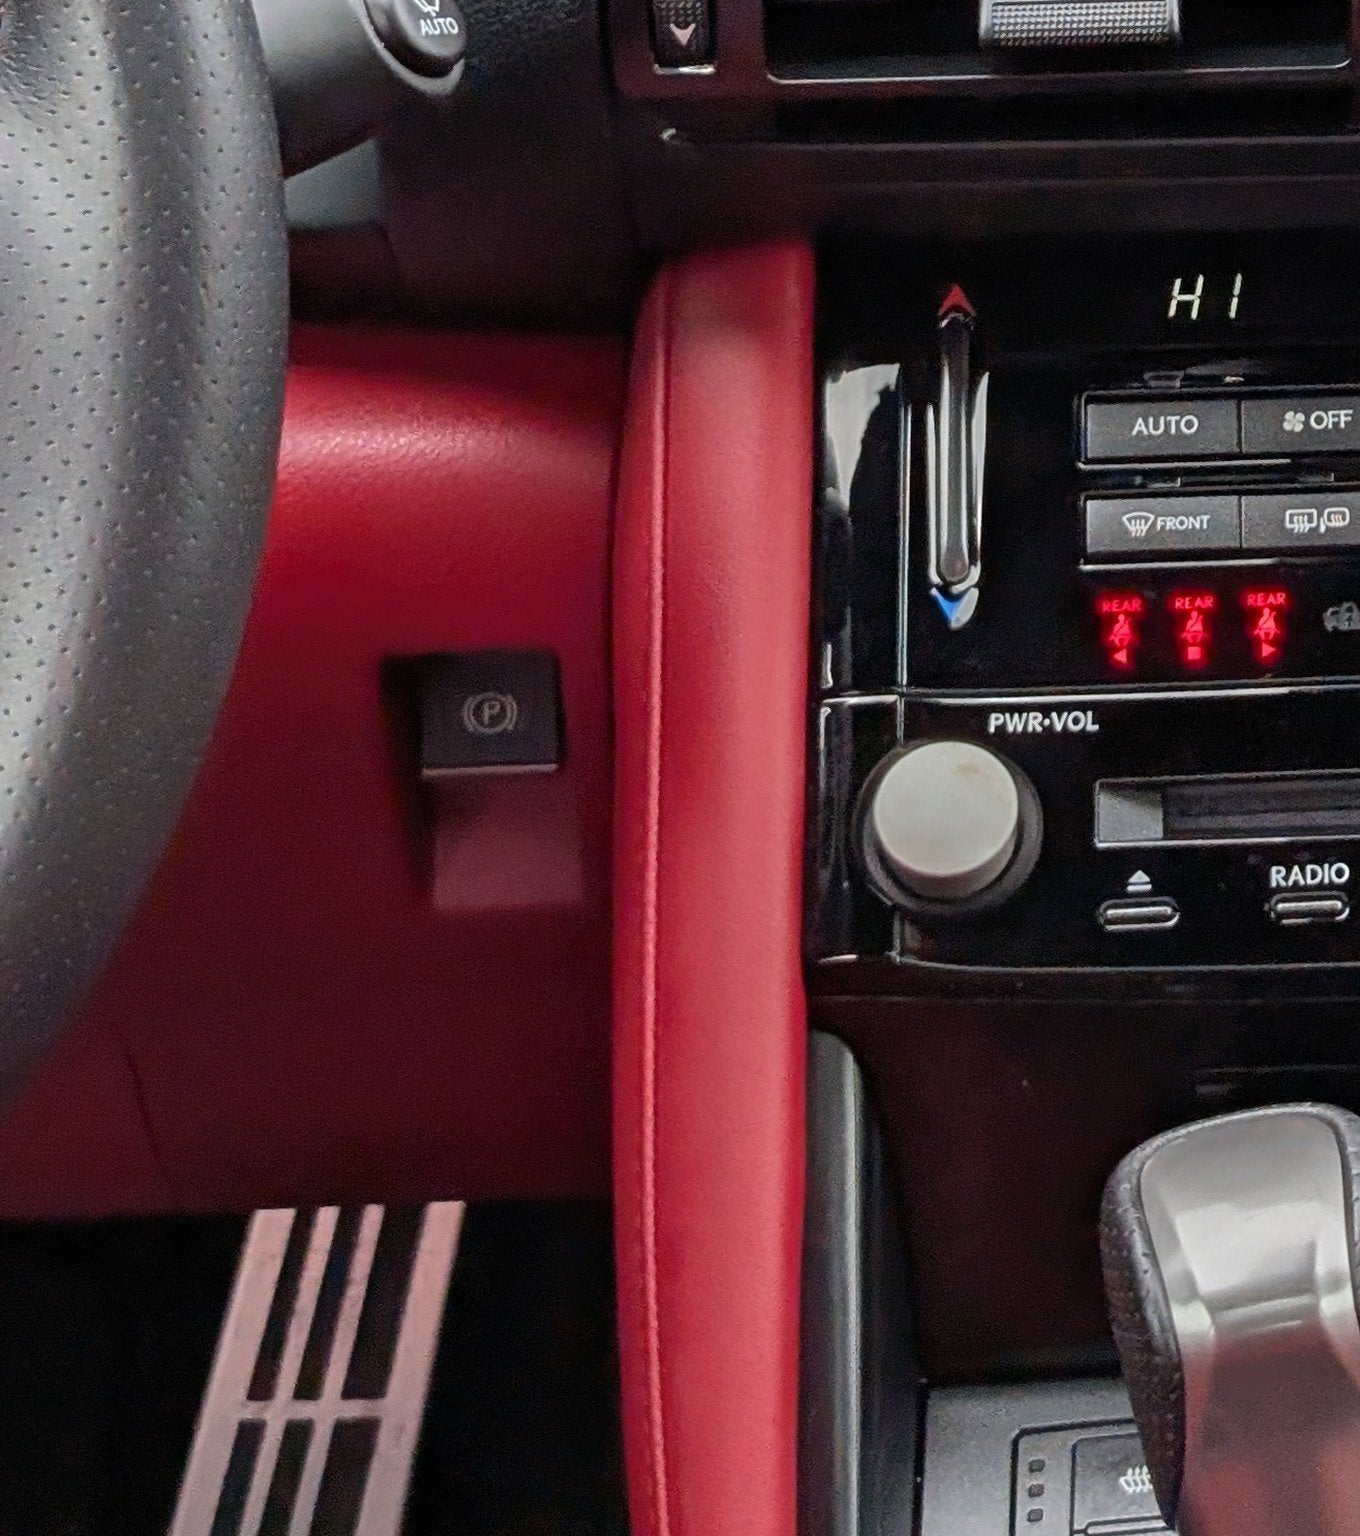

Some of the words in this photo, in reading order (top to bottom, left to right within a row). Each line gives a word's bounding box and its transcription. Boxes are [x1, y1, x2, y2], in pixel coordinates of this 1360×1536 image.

[420, 17, 459, 36] AUTO
[1131, 415, 1199, 436] AUTO
[1309, 409, 1353, 430] OFF
[1156, 514, 1211, 531] FRONT
[1102, 598, 1143, 613] REAR
[1174, 595, 1214, 610] REAR
[1247, 592, 1287, 606] REAR
[1269, 861, 1351, 889] RADIO
